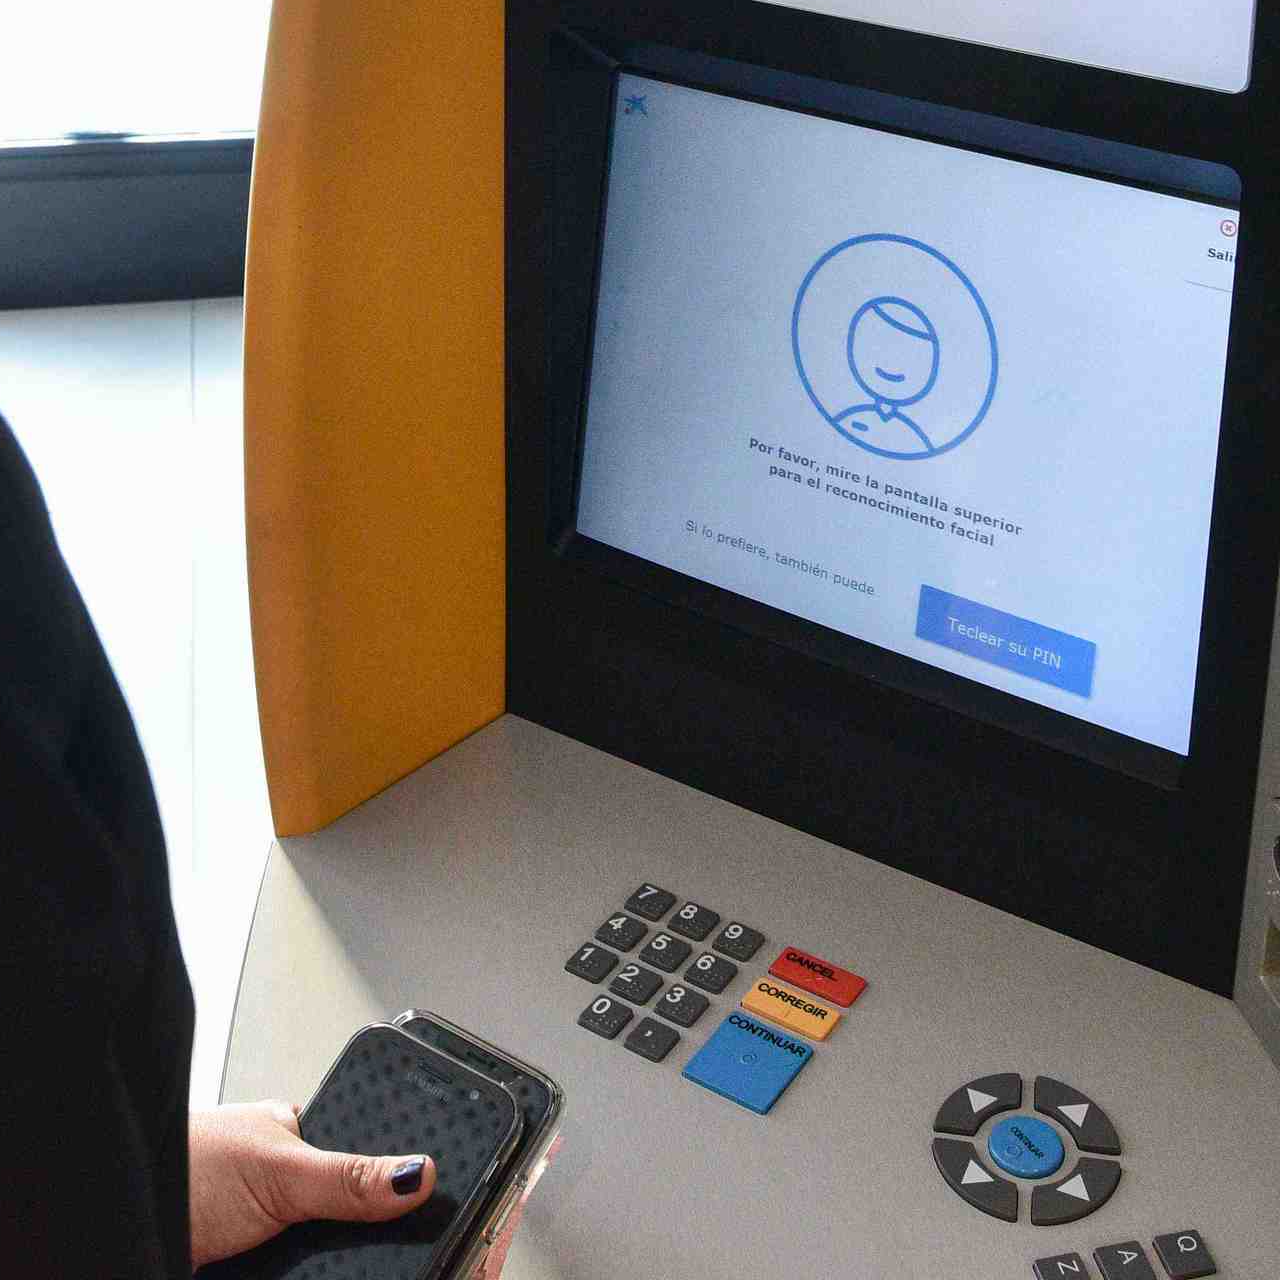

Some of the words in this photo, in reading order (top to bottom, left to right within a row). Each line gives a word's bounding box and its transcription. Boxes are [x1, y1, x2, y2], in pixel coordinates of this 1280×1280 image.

[1208, 247, 1233, 262] Sali
[749, 437, 775, 456] Por
[776, 446, 821, 473] favor,
[825, 463, 862, 484] mire
[865, 474, 880, 490] la
[884, 483, 950, 513] pantalla
[953, 504, 1023, 536] superior
[768, 463, 802, 484] para
[806, 475, 821, 491] el
[825, 482, 946, 531] reconocimiento
[950, 521, 996, 547] facial
[685, 519, 698, 534] Si
[702, 524, 713, 538] lo
[717, 532, 771, 561] prefiere,
[775, 551, 829, 580] también
[832, 572, 876, 597] puede
[946, 615, 1007, 649] Teclear
[1008, 641, 1028, 657] su
[1033, 646, 1063, 670] PIN
[637, 885, 659, 899] 7
[679, 904, 699, 920] 8
[608, 916, 628, 930] 4
[723, 924, 744, 939] 9
[651, 934, 672, 951] 5
[579, 947, 596, 961] 1
[695, 954, 717, 971] 6
[618, 965, 640, 983] 2
[786, 951, 839, 982] CANCEL
[665, 986, 686, 1003] 3
[757, 982, 829, 1021] CORREGIR
[591, 998, 612, 1015] 0
[728, 1014, 807, 1058] CONTINUAR
[1176, 1235, 1198, 1254] Q
[1117, 1249, 1139, 1265] A
[1056, 1259, 1081, 1275] Z
